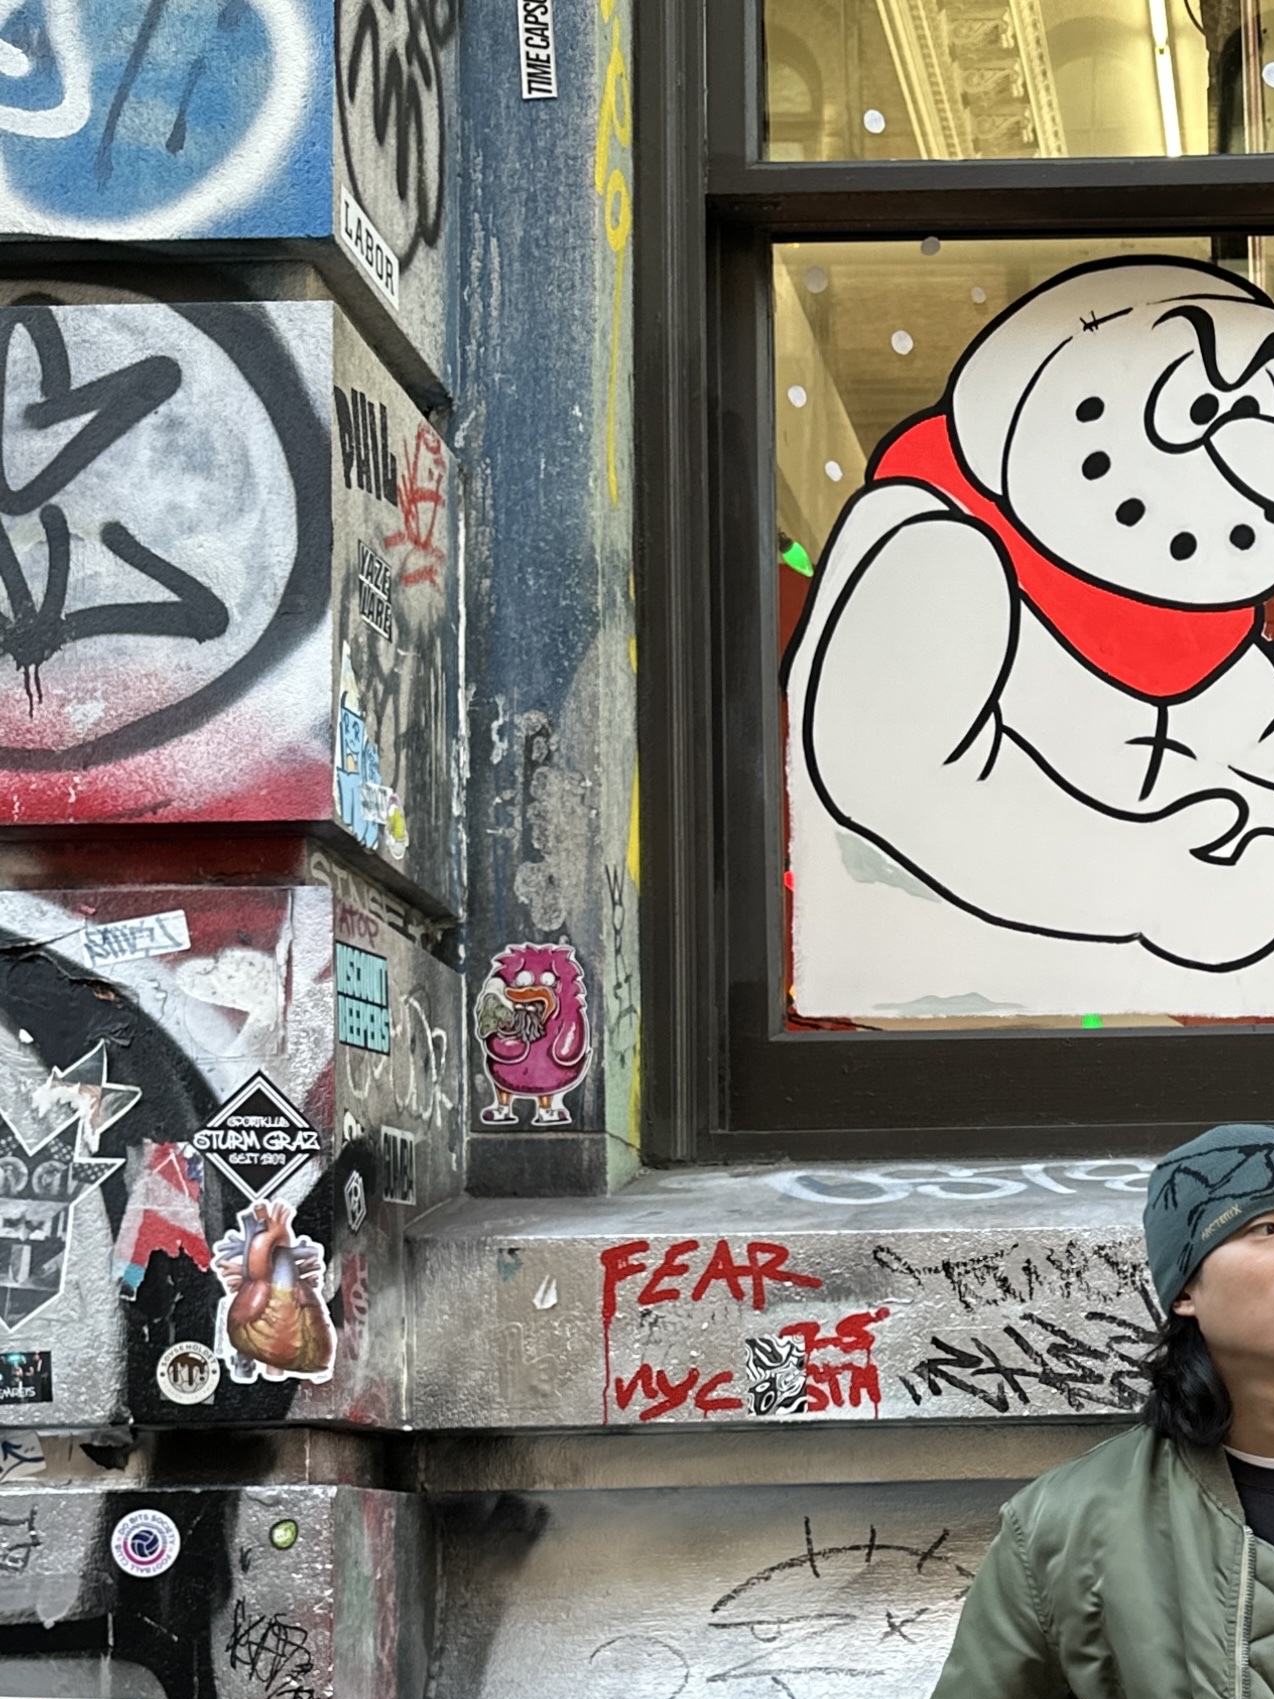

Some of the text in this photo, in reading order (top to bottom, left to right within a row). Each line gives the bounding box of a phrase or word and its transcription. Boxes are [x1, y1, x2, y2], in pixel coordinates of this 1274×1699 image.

[526, 51, 553, 95] TIME
[344, 200, 395, 296] LABOR
[226, 1115, 290, 1128] SPORTKLUB
[193, 1129, 320, 1152] STURM GRAZ
[228, 1152, 260, 1165] SEIT
[600, 1240, 823, 1314] FEAR
[128, 1513, 150, 1525] BITS
[151, 1514, 176, 1546] SOCIETY
